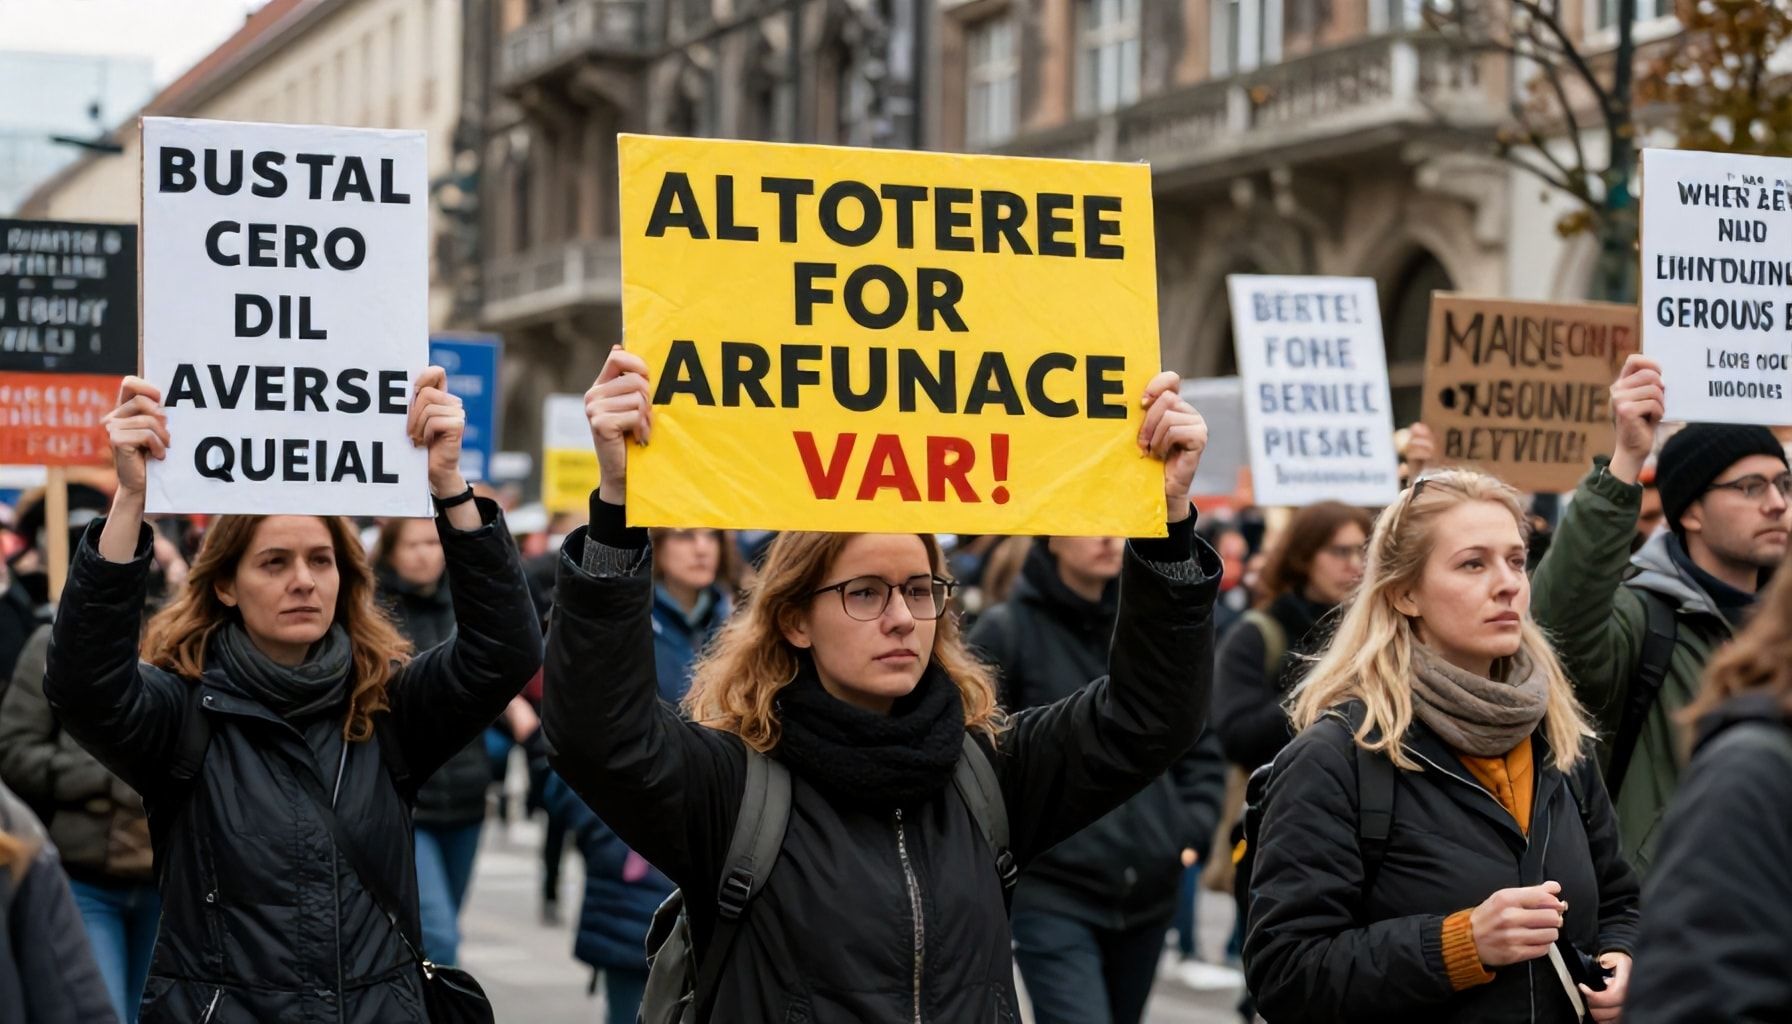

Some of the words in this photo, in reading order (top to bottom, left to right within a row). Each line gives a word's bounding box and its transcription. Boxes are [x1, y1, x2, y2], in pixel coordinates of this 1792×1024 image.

[160, 146, 411, 204] BUSTAL
[645, 171, 1125, 260] ALTOTEREE
[205, 220, 366, 271] CERO
[234, 293, 327, 340] DIL
[794, 262, 969, 332] FOR
[164, 363, 408, 415] AVERSE
[652, 340, 1128, 420] ARFUNACE
[194, 436, 399, 484] QUEIAL
[793, 431, 1010, 505] VAR!
